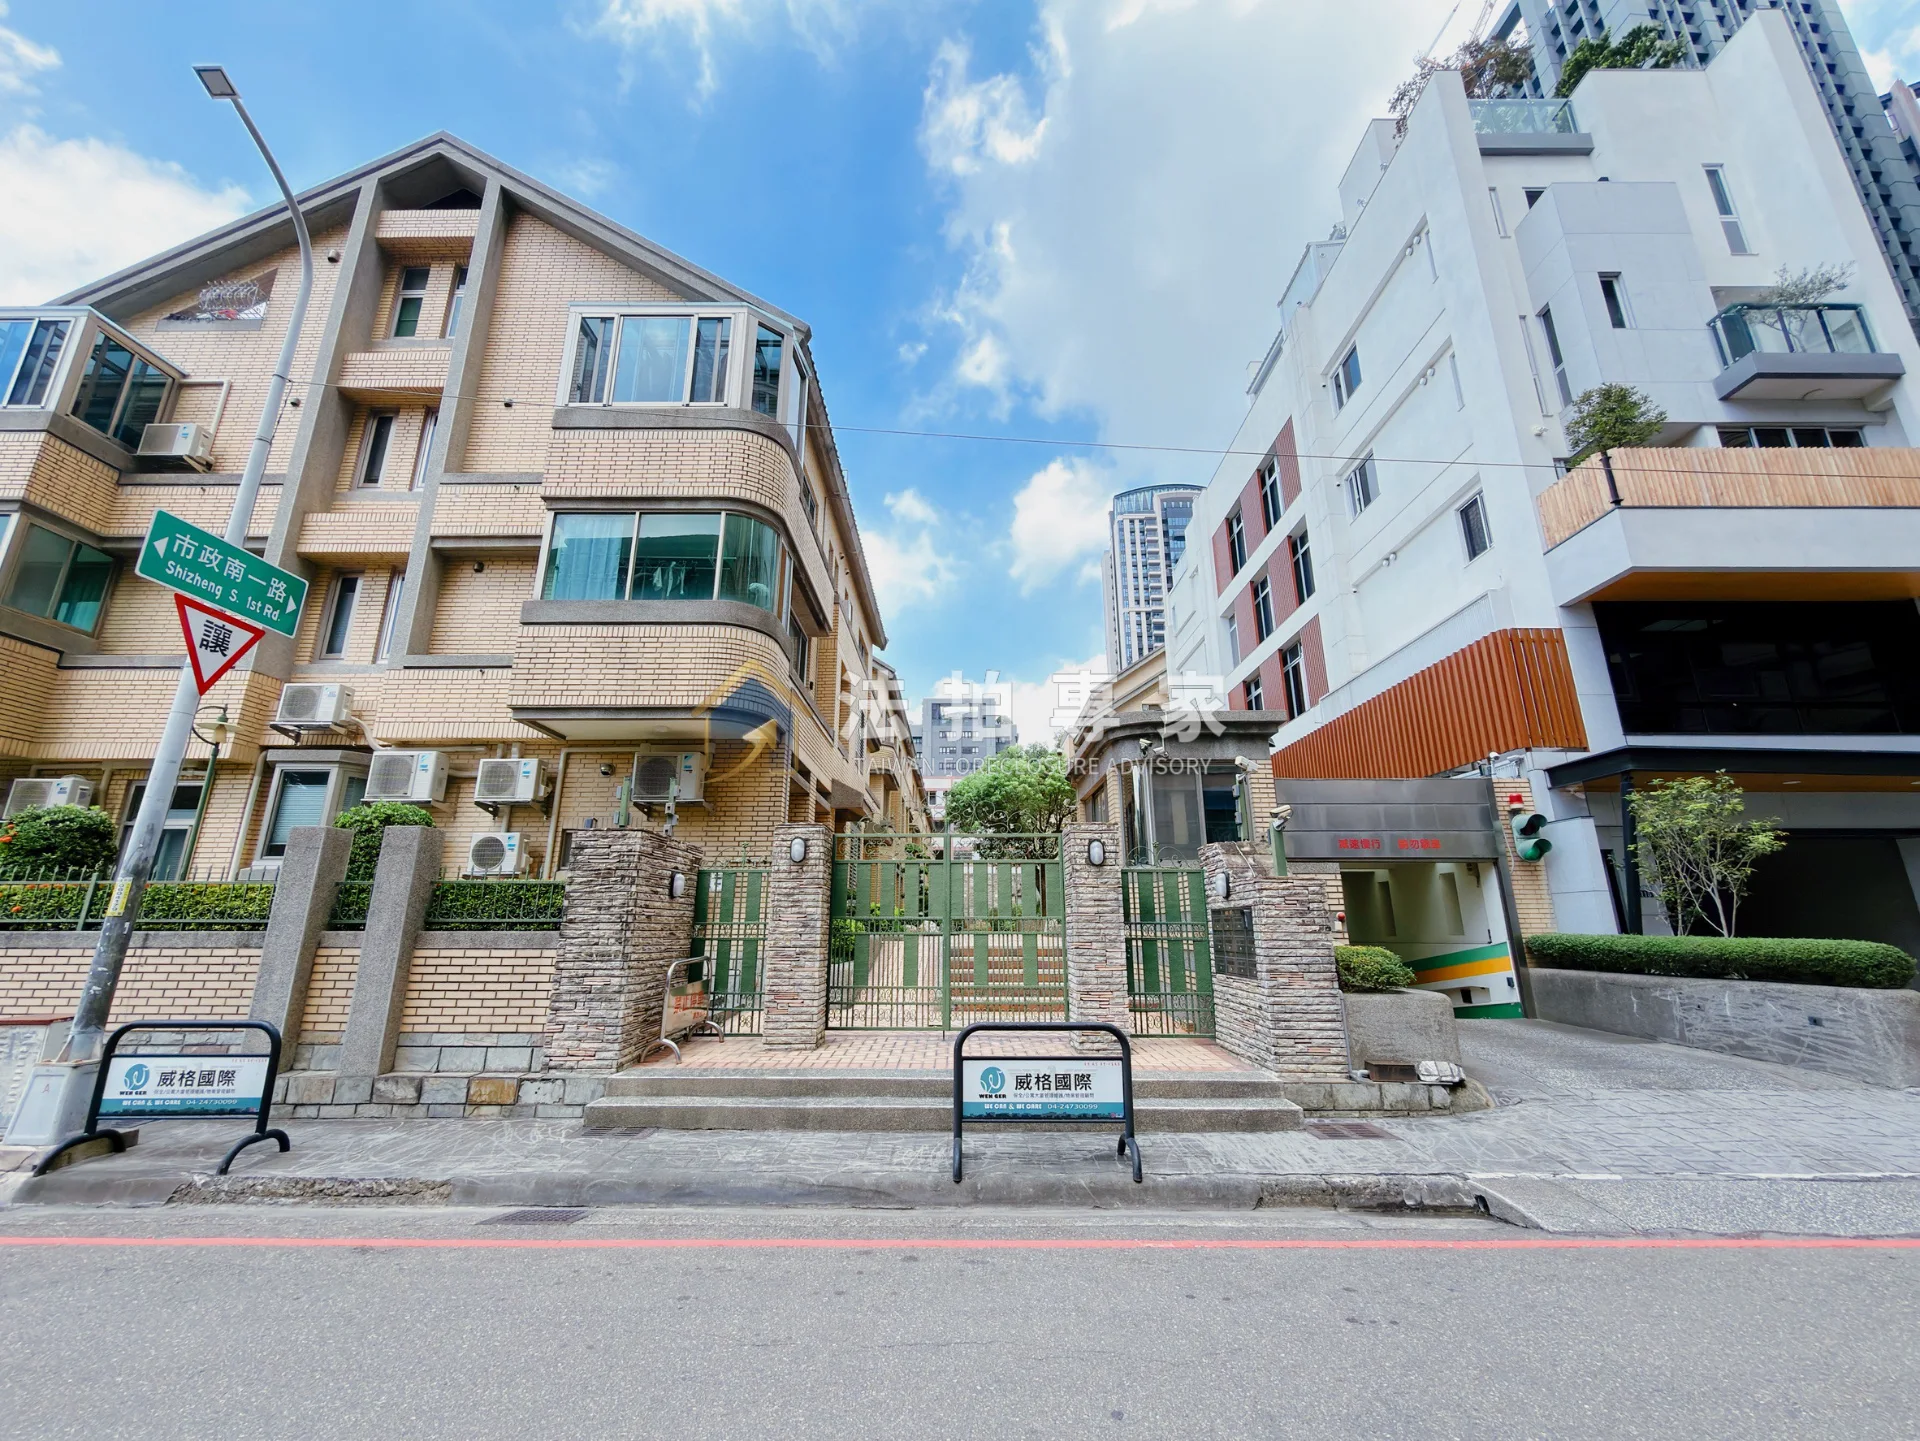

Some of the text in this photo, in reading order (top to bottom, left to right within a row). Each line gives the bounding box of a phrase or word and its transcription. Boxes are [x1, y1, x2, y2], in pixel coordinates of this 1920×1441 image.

[172, 532, 287, 604] 市政南一路
[165, 560, 281, 622] Shizheng S. 1st Rd.
[198, 618, 233, 658] 讓
[156, 1069, 237, 1087] 威格國際
[1014, 1072, 1093, 1091] 威格國際
